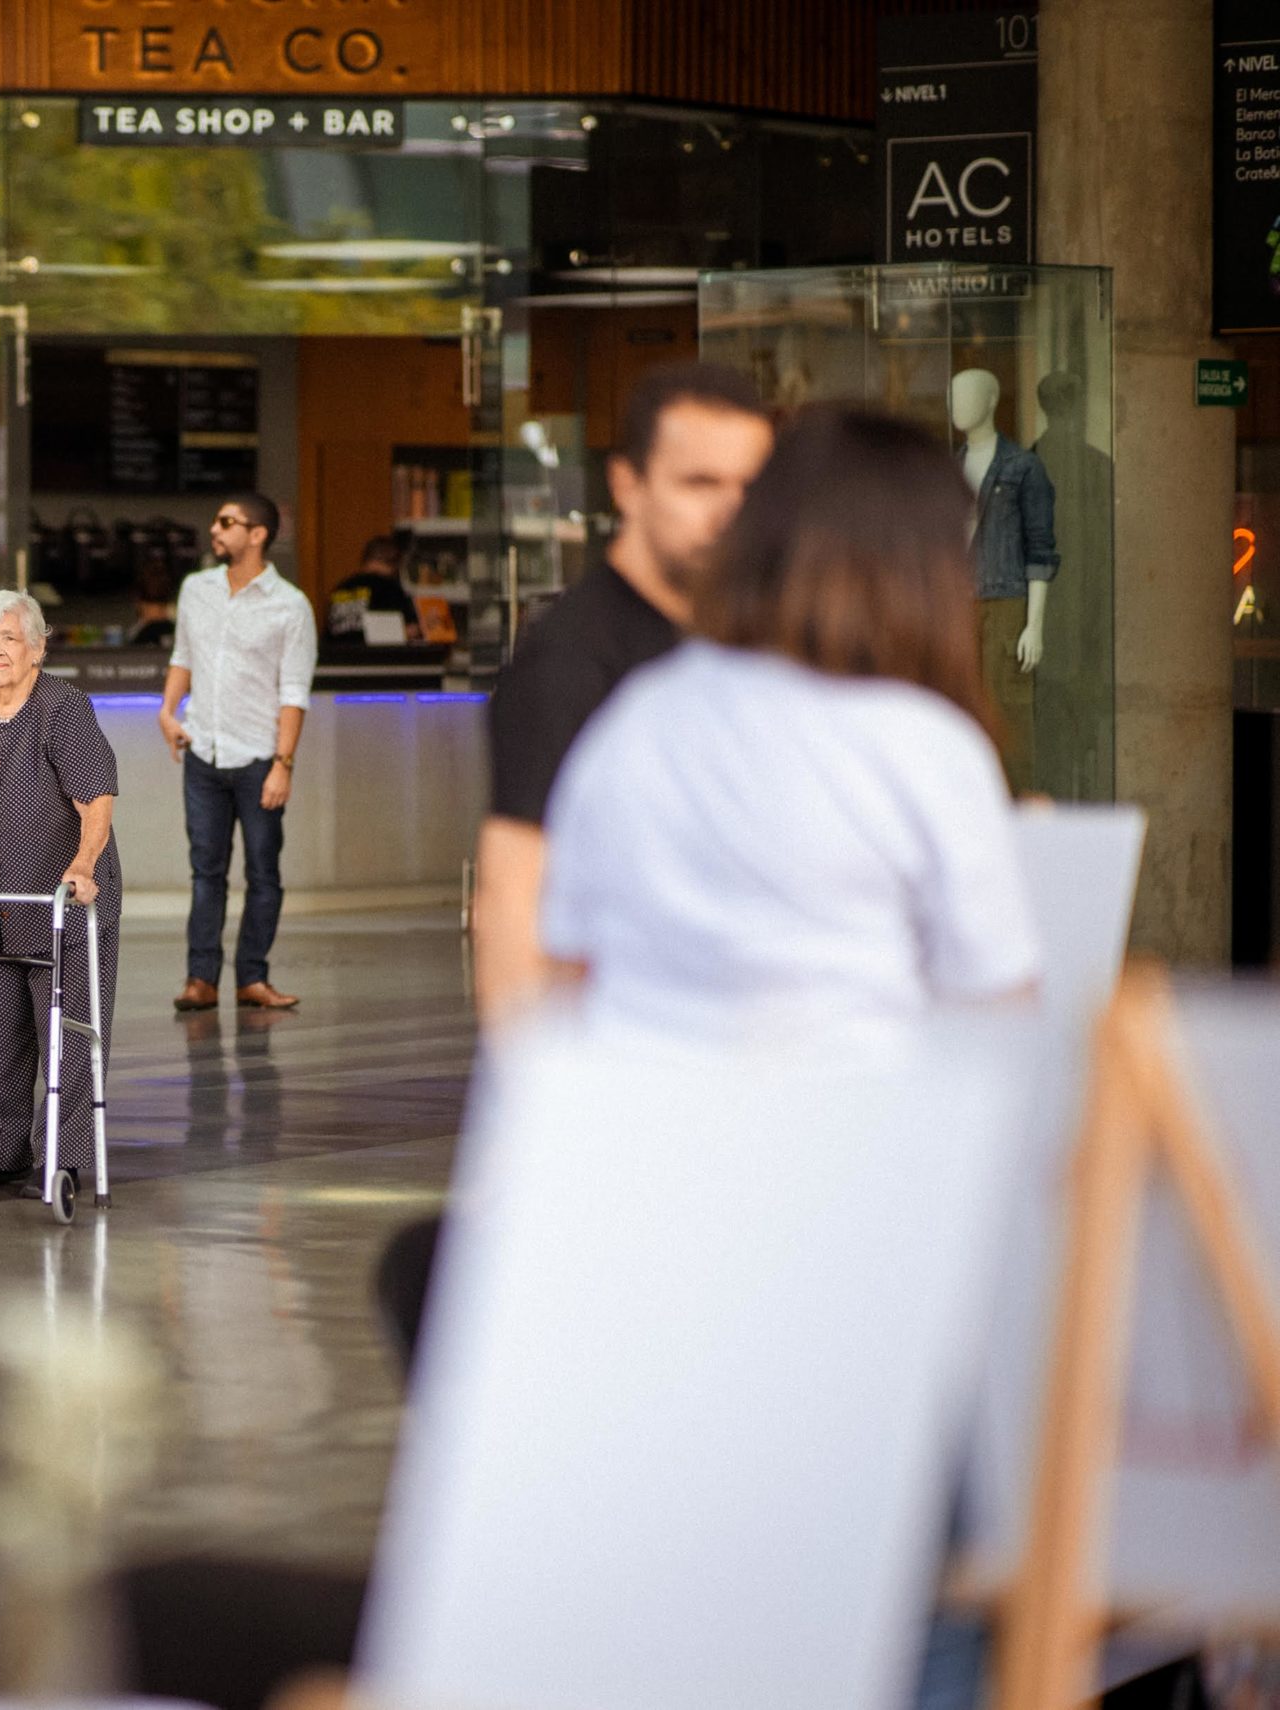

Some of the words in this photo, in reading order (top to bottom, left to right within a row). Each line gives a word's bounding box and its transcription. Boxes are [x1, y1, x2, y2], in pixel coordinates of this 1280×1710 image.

[82, 26, 234, 73] TEA
[283, 27, 408, 75] CO.
[1238, 55, 1279, 72] NIVEL
[895, 85, 937, 102] NIVEL
[939, 83, 947, 99] 1
[93, 107, 163, 134] TEA
[175, 108, 275, 134] SHOP
[288, 112, 309, 132] +
[323, 109, 395, 135] BAR
[907, 157, 1011, 220] AC
[905, 225, 1012, 248] HOTELS
